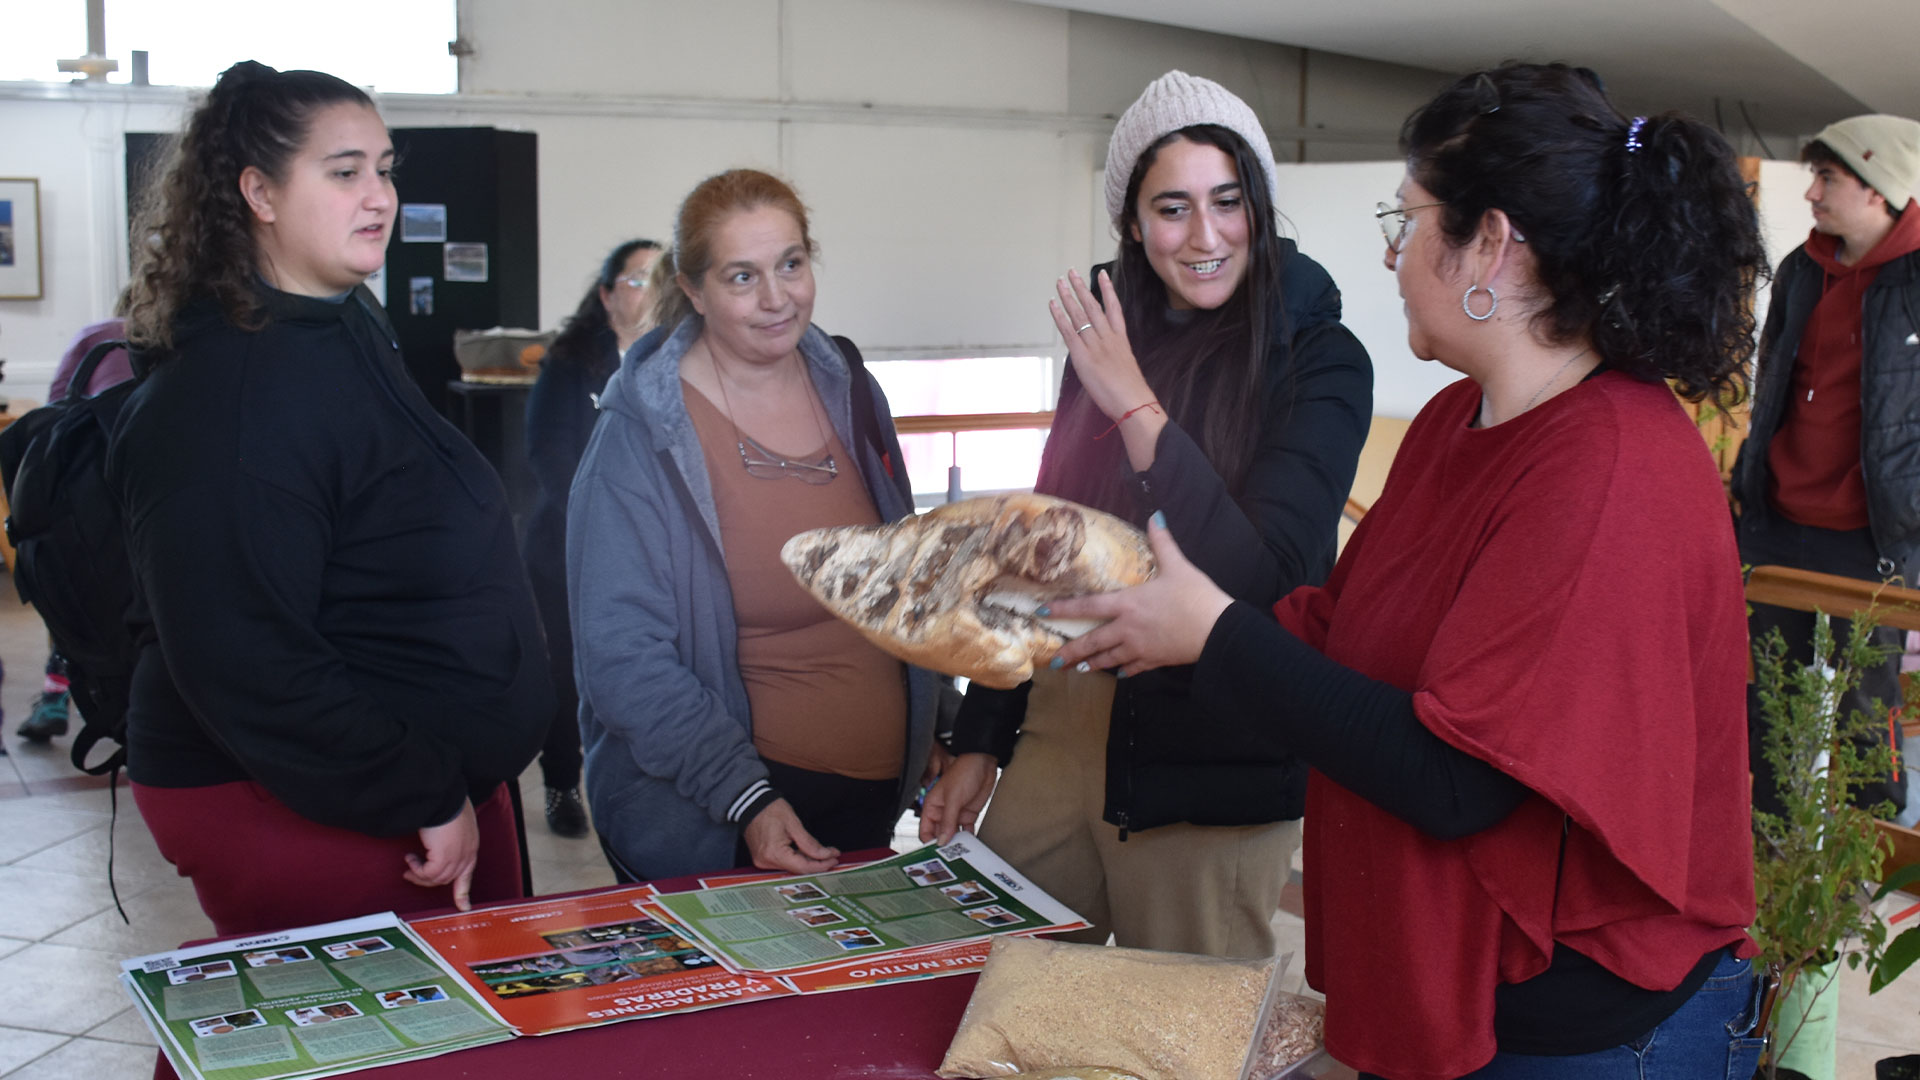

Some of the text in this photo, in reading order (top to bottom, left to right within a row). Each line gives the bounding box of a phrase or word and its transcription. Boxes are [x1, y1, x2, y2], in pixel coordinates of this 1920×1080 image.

[848, 960, 940, 978] NATIVO
[587, 984, 771, 1018] PLANTACIONES
[613, 979, 740, 1006] PRADERAS
